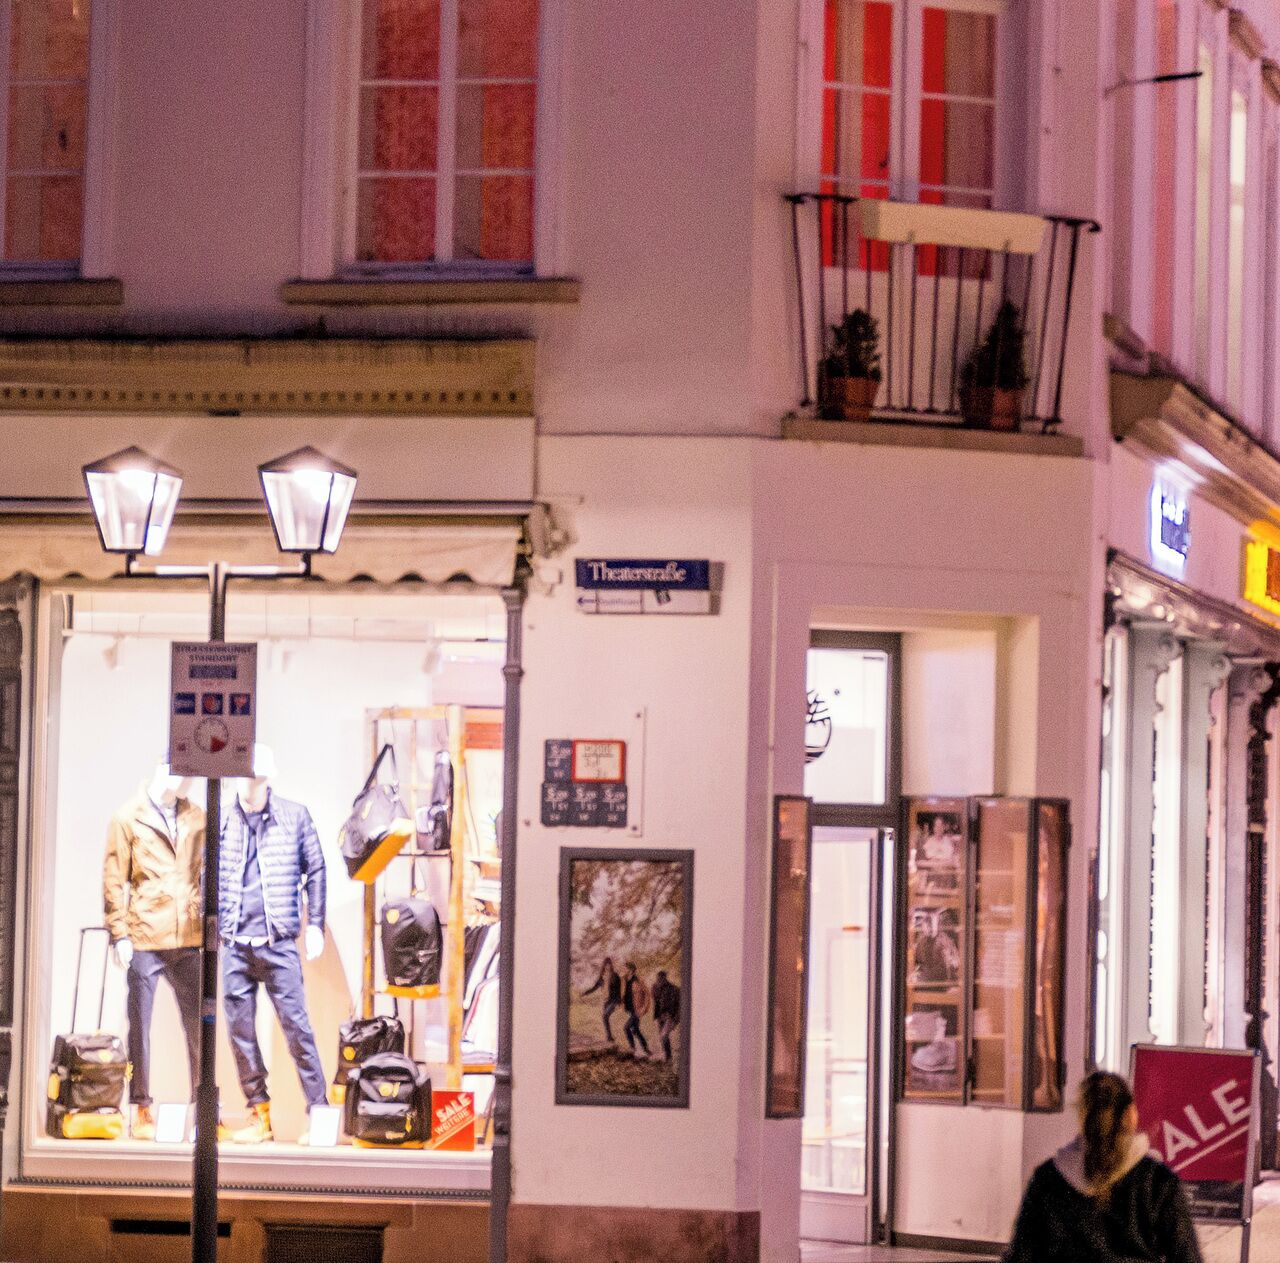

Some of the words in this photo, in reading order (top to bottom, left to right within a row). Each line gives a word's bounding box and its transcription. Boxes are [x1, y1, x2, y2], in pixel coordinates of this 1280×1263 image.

[587, 561, 687, 582] Theaterstraße
[434, 1091, 473, 1124] SALE
[1148, 1079, 1251, 1162] ALE
